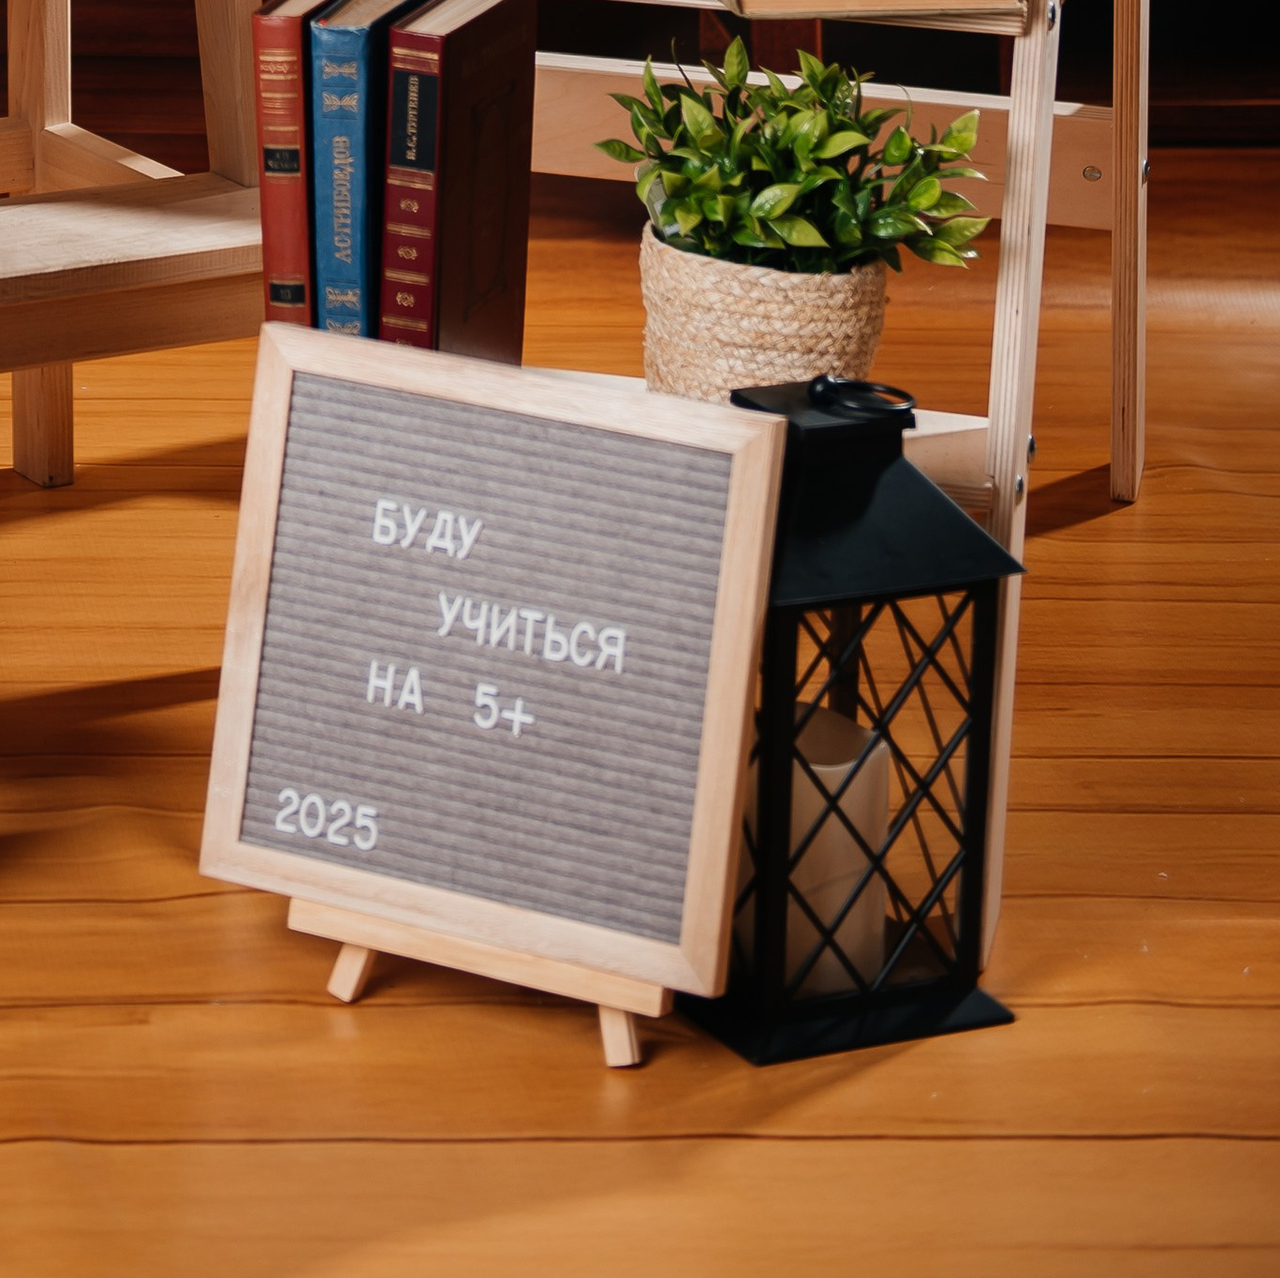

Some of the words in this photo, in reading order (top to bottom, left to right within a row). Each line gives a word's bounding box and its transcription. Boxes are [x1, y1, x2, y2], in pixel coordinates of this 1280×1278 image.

[371, 497, 484, 561] БУДУ
[435, 590, 628, 675] УЧИТЬСЯ
[365, 658, 425, 716] НА
[472, 682, 536, 739] 5+
[273, 786, 380, 852] 2025
